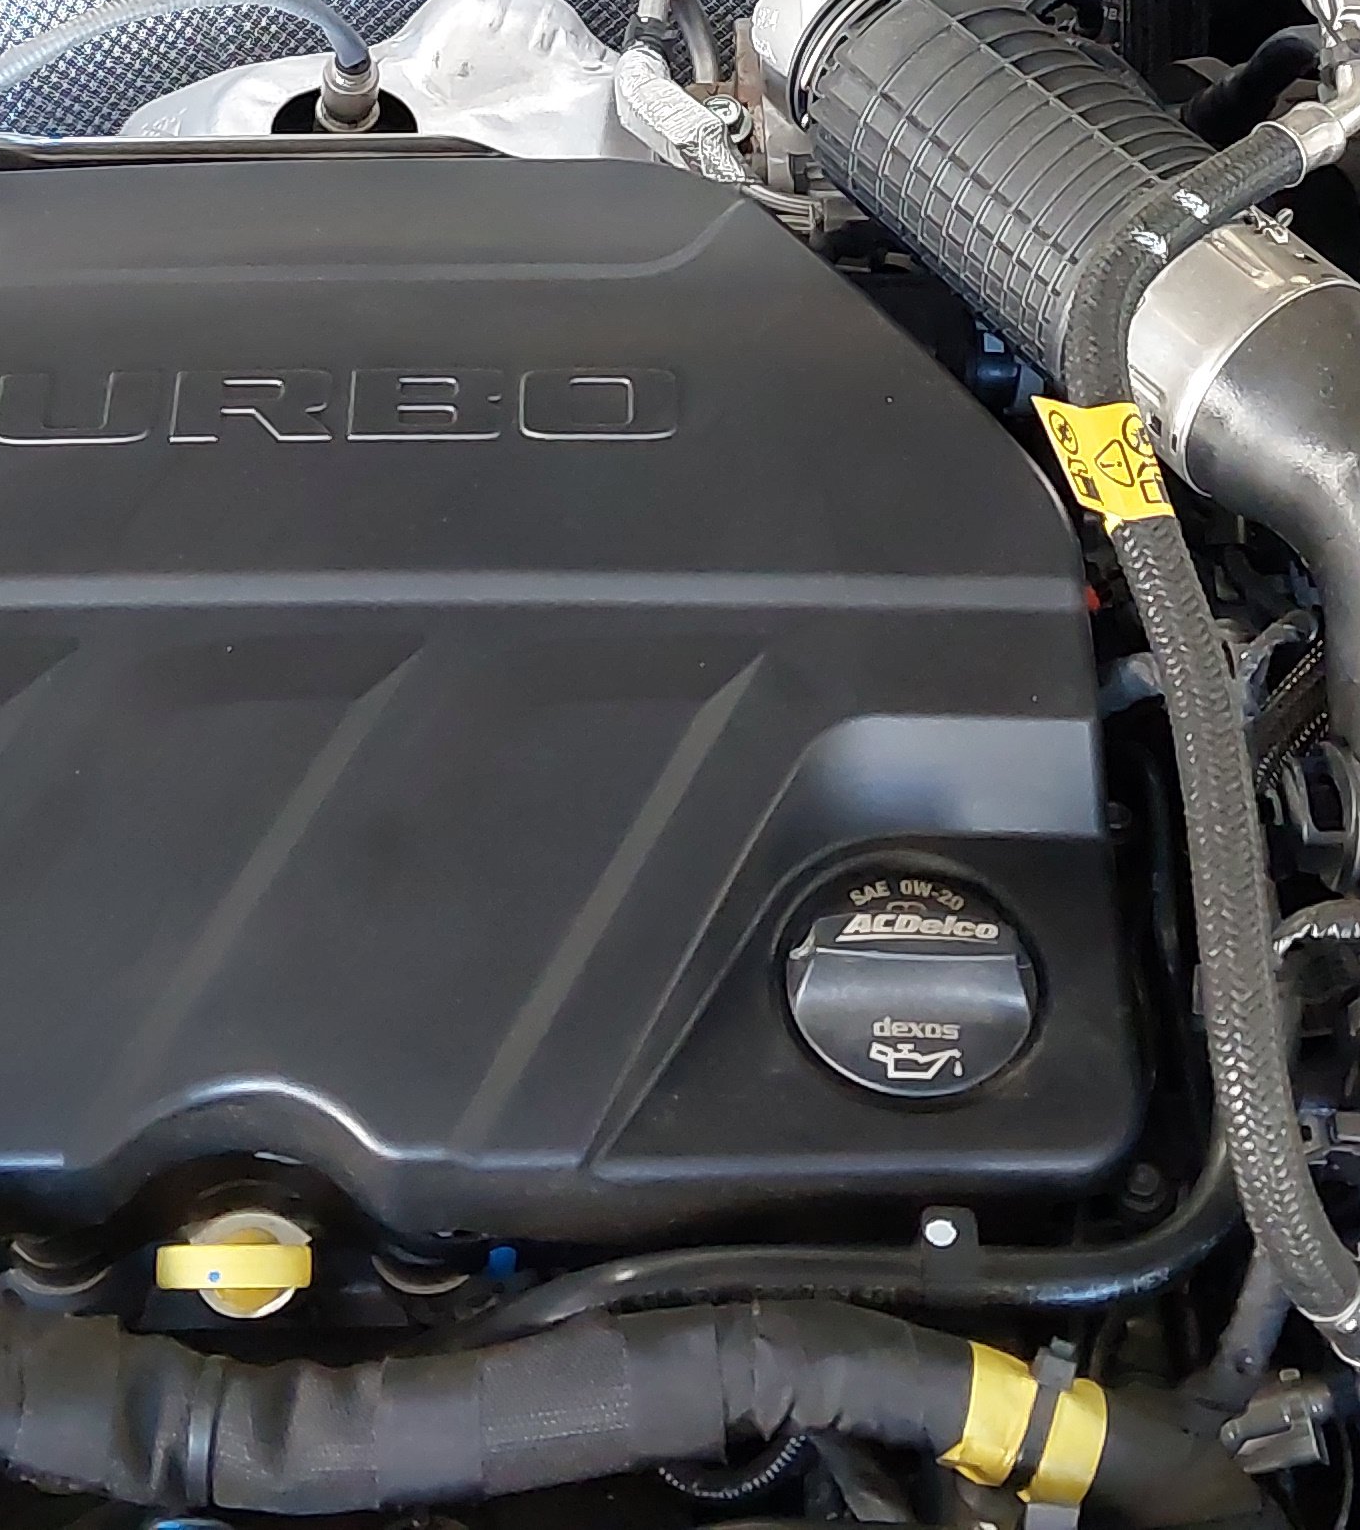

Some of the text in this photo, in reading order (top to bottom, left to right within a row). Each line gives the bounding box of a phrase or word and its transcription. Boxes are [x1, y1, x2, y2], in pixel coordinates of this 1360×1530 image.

[848, 878, 966, 912] SAE 0W-20
[842, 913, 1000, 940] ACDelco
[872, 1015, 961, 1040] dexos
